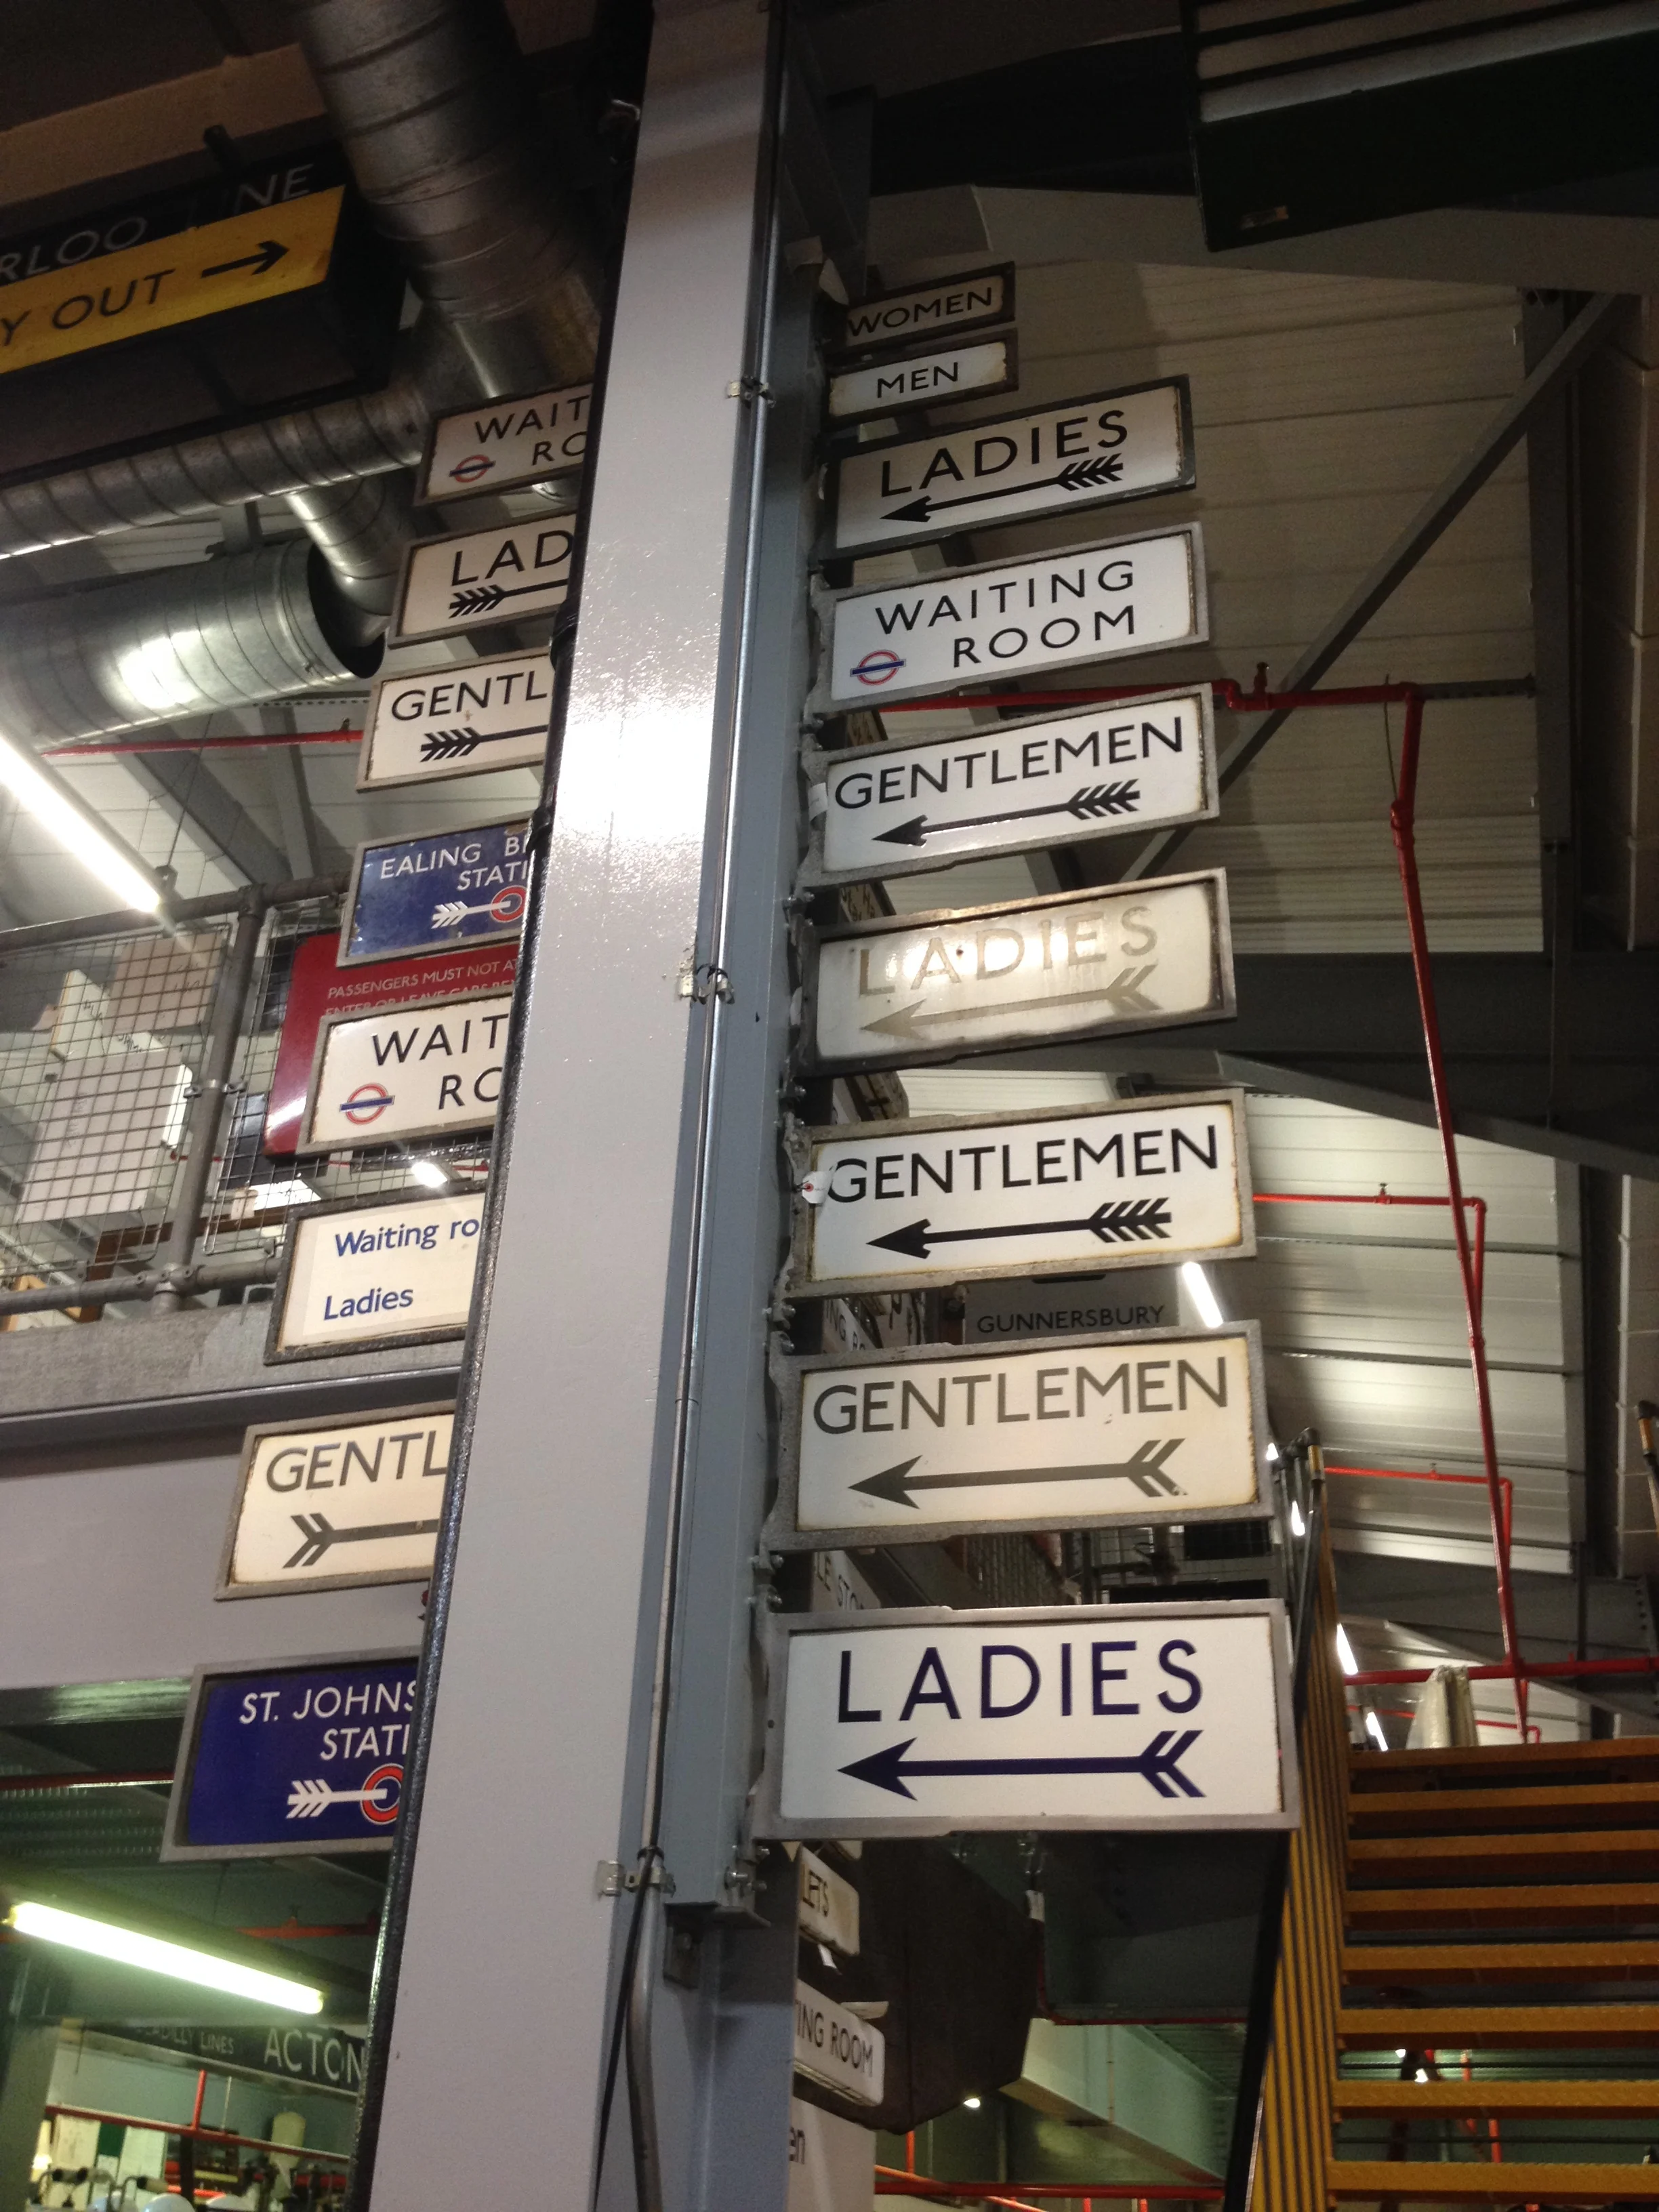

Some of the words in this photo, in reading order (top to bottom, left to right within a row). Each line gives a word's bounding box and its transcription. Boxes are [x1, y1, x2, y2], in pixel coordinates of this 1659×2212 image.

[52, 268, 176, 330] OUT
[847, 286, 991, 337] WOMEN
[876, 361, 959, 399] MEN
[475, 394, 591, 445] WAIT
[881, 409, 1128, 498] LADIES
[451, 529, 573, 587] LAD
[875, 560, 1134, 636] WAITING
[953, 605, 1135, 668] ROOM
[391, 670, 548, 722] GENTL
[834, 716, 1183, 810] GENTLEMEN
[380, 842, 481, 880] EALING
[456, 859, 529, 891] STATI
[859, 905, 1158, 998] LADIES
[327, 974, 419, 1000] PASSENGERS
[422, 966, 464, 984] MUST
[467, 960, 501, 977] NOT
[371, 1012, 510, 1067] WAIT
[827, 1124, 1219, 1204] GENTLEMEN
[334, 1221, 439, 1258] Waiting
[449, 1218, 480, 1240] ro
[323, 1286, 414, 1321] Ladies
[977, 1305, 1166, 1334] GUNNERSBURY
[813, 1355, 1229, 1435] GENTLEMEN
[265, 1430, 448, 1493] GENTL
[239, 1690, 281, 1725] ST.
[837, 1639, 1204, 1723] LADIES
[319, 1722, 411, 1761] STATI
[263, 2026, 368, 2085] ACTON
[830, 2020, 874, 2078] ROOM
